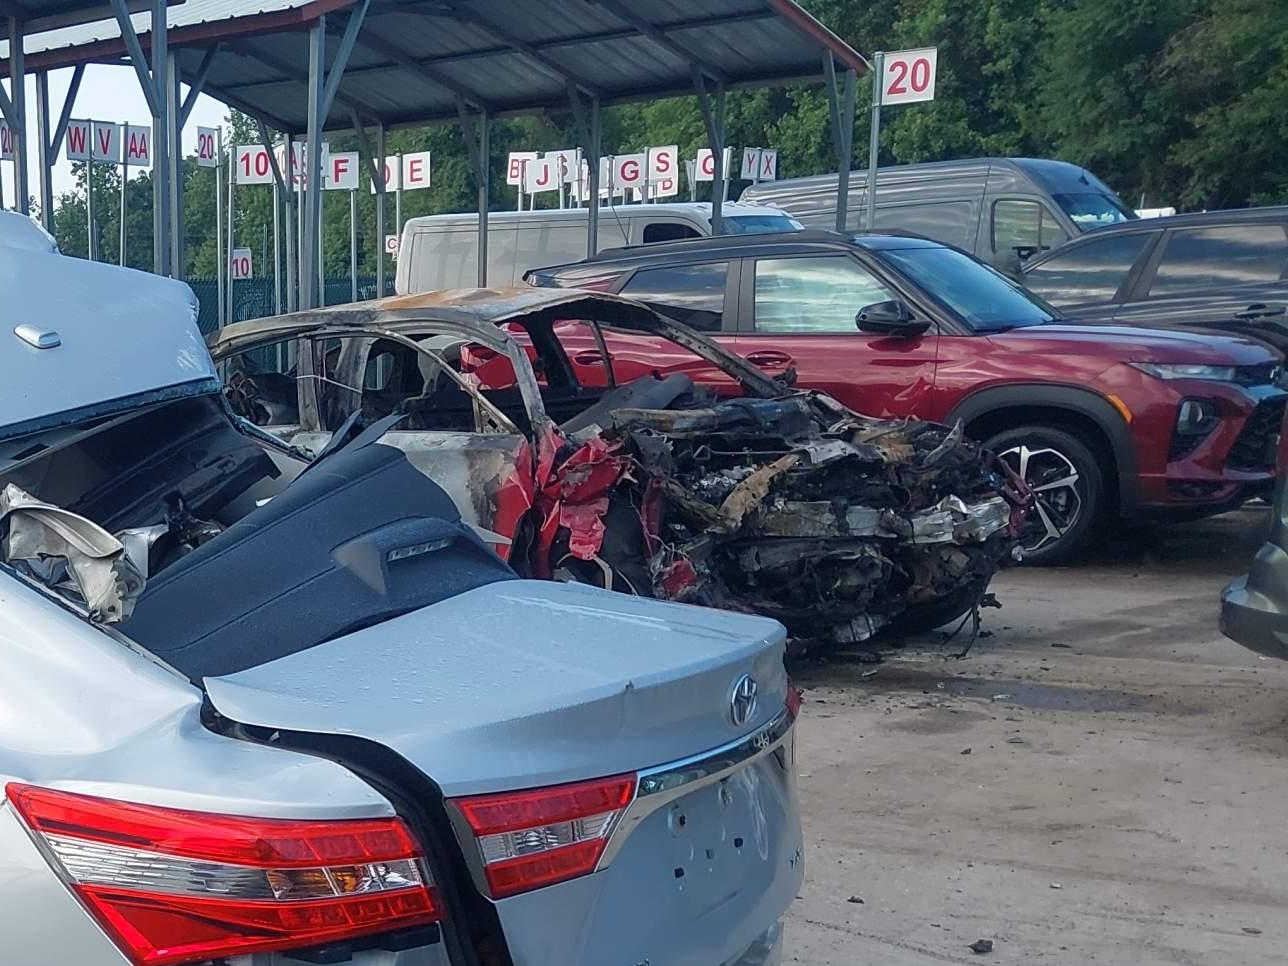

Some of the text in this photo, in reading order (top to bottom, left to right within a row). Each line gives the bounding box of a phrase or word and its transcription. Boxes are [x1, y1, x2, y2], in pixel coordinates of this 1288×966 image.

[887, 58, 931, 95] 20
[67, 126, 87, 153] W
[98, 128, 111, 155] V
[128, 131, 148, 159] AA
[199, 133, 215, 160] 20
[240, 151, 269, 177] 10
[334, 159, 350, 183] F
[409, 159, 424, 183] E
[620, 160, 640, 182] G
[655, 152, 670, 173] S
[747, 153, 756, 174] Y
[763, 154, 773, 176] X
[535, 164, 549, 186] J
[232, 256, 250, 278] 10
